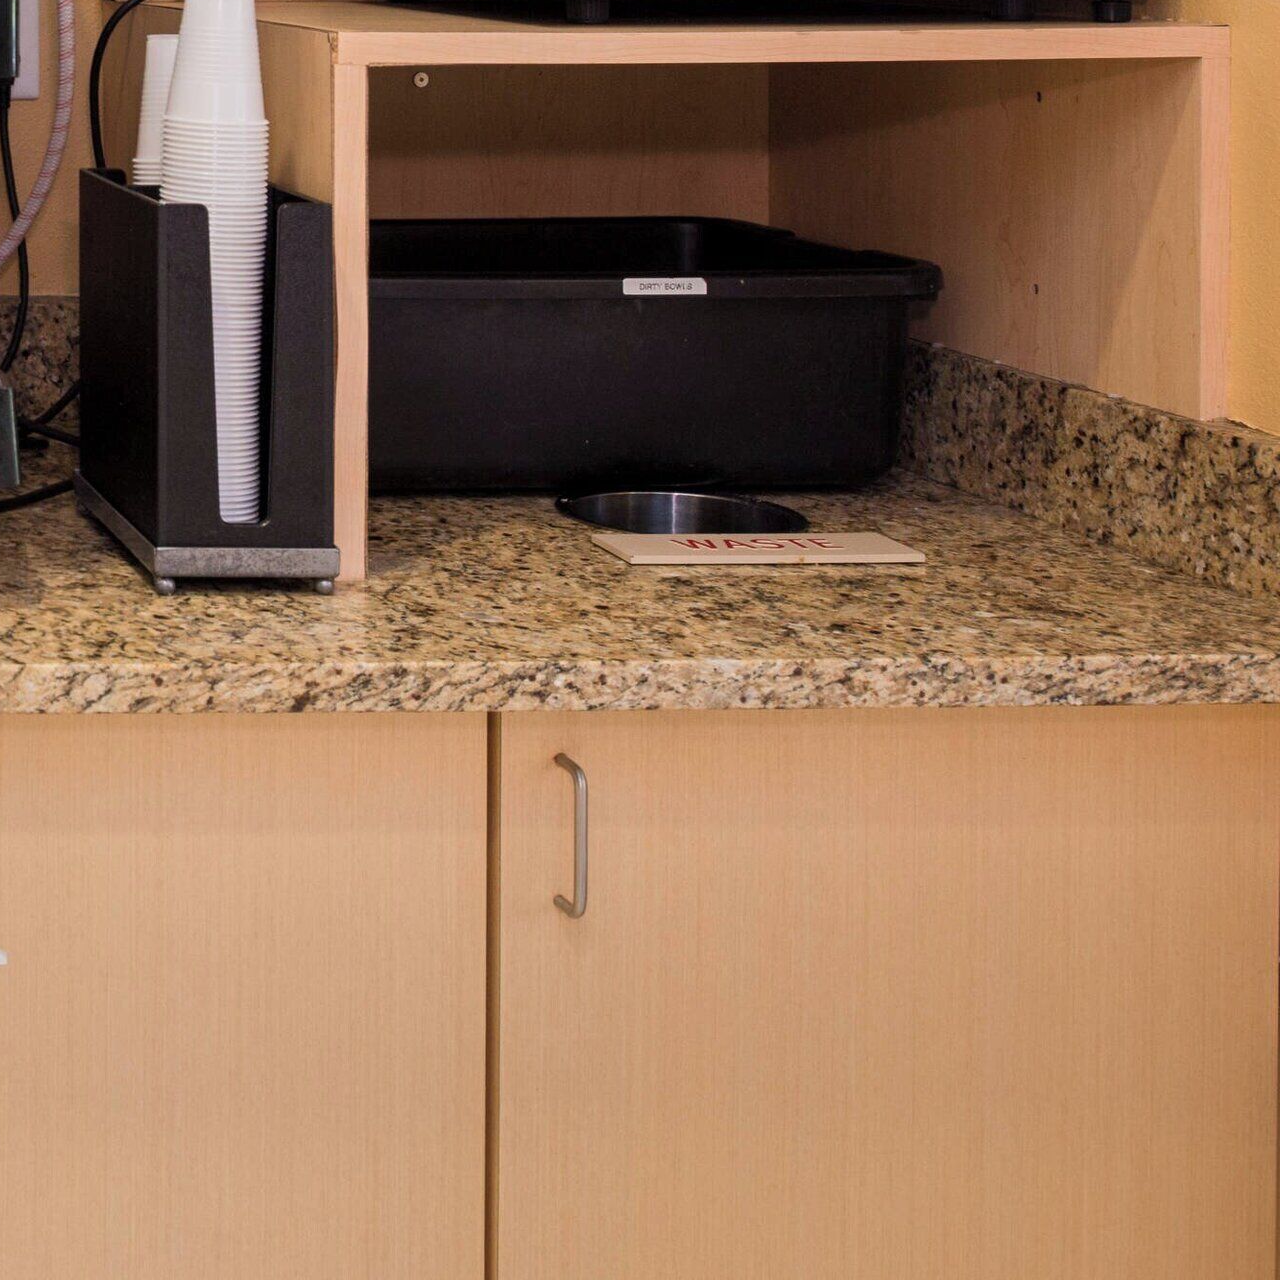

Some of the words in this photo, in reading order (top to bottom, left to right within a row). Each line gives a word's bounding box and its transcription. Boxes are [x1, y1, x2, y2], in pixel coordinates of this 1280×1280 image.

[639, 283, 661, 291] DIRTY
[665, 283, 693, 291] BOWLS
[670, 538, 844, 550] WASTE
